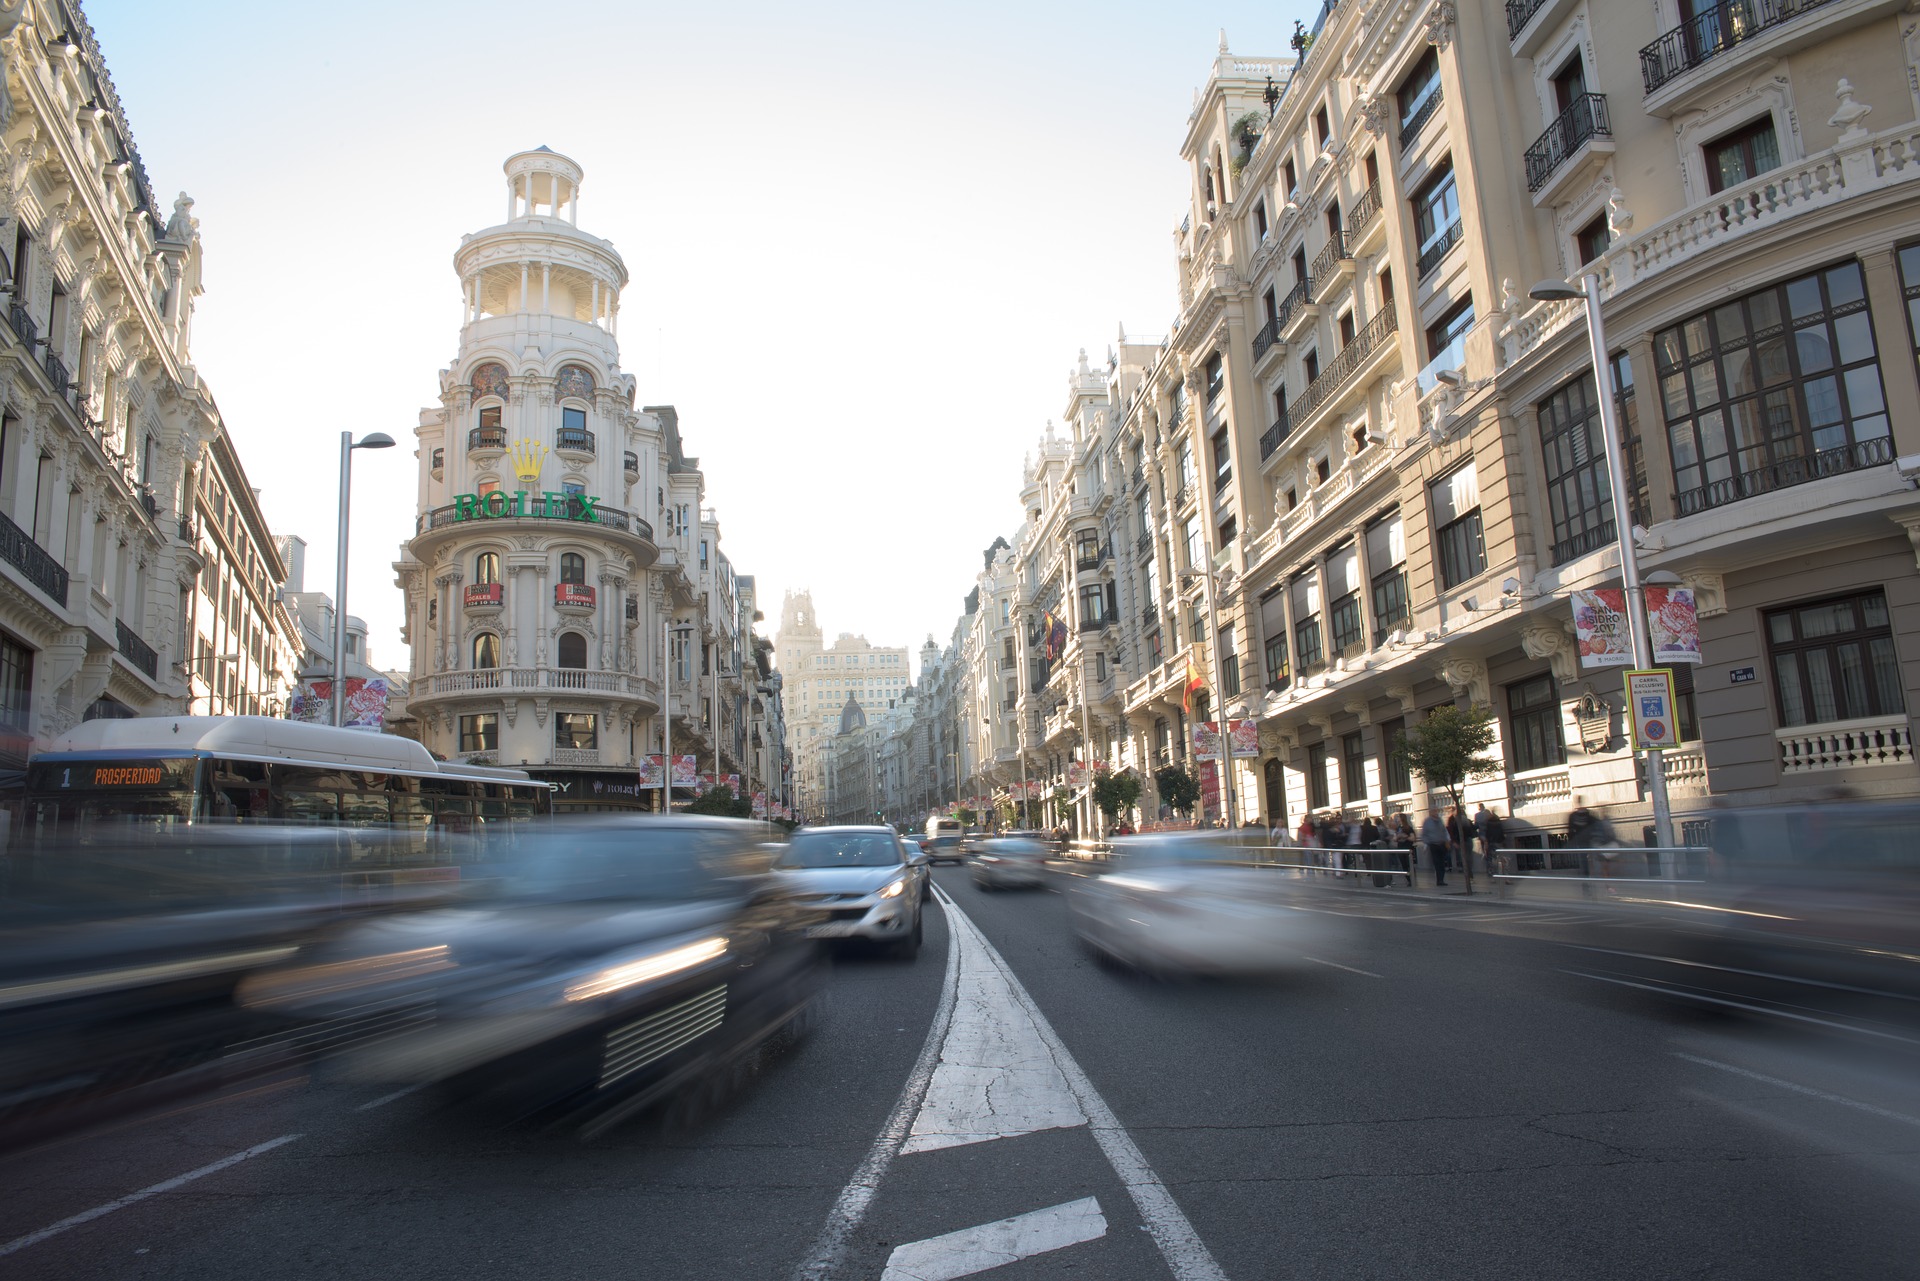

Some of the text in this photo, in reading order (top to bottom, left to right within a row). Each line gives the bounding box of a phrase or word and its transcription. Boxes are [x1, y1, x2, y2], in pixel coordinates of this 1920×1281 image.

[453, 490, 602, 523] ROLEX
[466, 594, 491, 602] LOCALES
[1590, 605, 1612, 614] SAN
[1585, 614, 1620, 624] ISIDRO
[1593, 623, 1616, 633] 2017
[300, 708, 318, 716] 2017
[61, 767, 161, 788] 1 PROSPERIDAD
[607, 784, 634, 795] ROLEX
